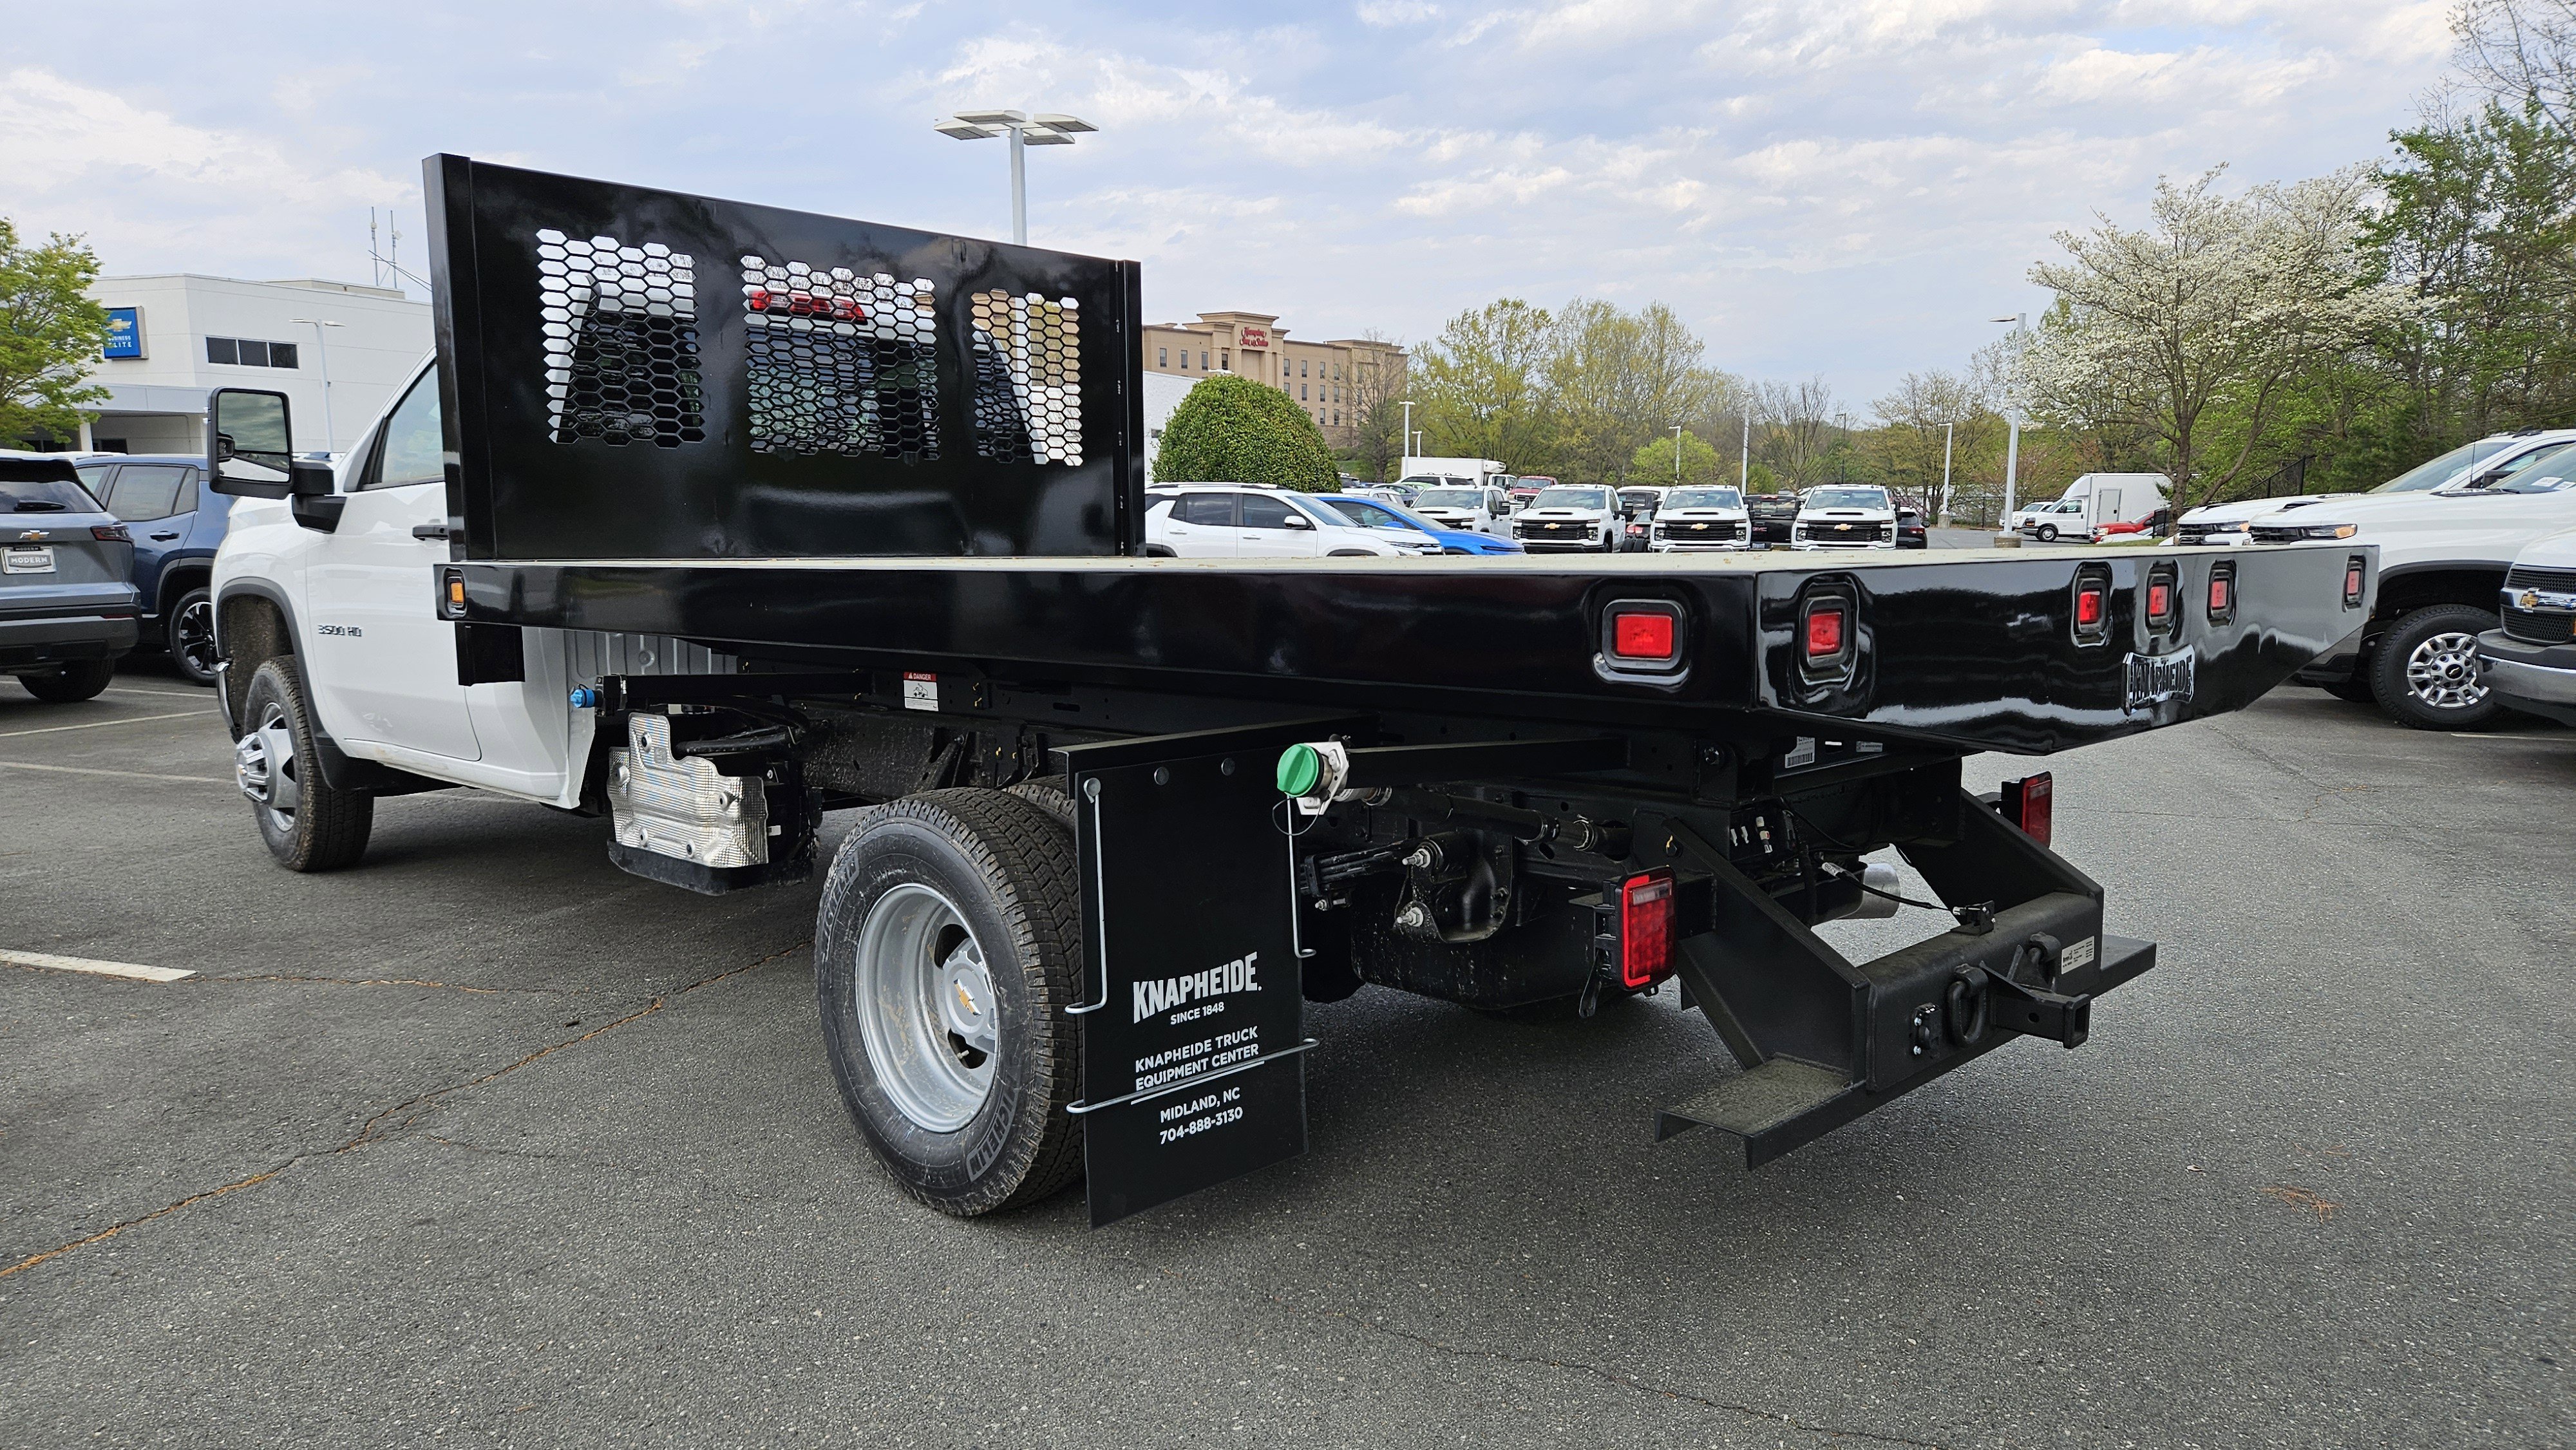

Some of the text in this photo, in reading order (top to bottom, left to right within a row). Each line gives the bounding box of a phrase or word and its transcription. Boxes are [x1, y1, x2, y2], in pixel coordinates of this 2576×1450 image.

[1240, 337, 1251, 346] Inn
[1255, 338, 1268, 347] Suites
[1241, 326, 1267, 337] Hampton
[318, 625, 362, 637] 3500 HD
[2130, 653, 2193, 706] KNAPHEIDE
[1170, 1001, 1225, 1025] SINCE 1848
[1135, 1025, 1258, 1073] KNAPHEIDE TRUCK
[1135, 1043, 1259, 1091] EQUIPMENT CENTER
[1160, 1086, 1241, 1123] MIDLAND, NC
[1160, 1106, 1244, 1145] 704-888-3130
